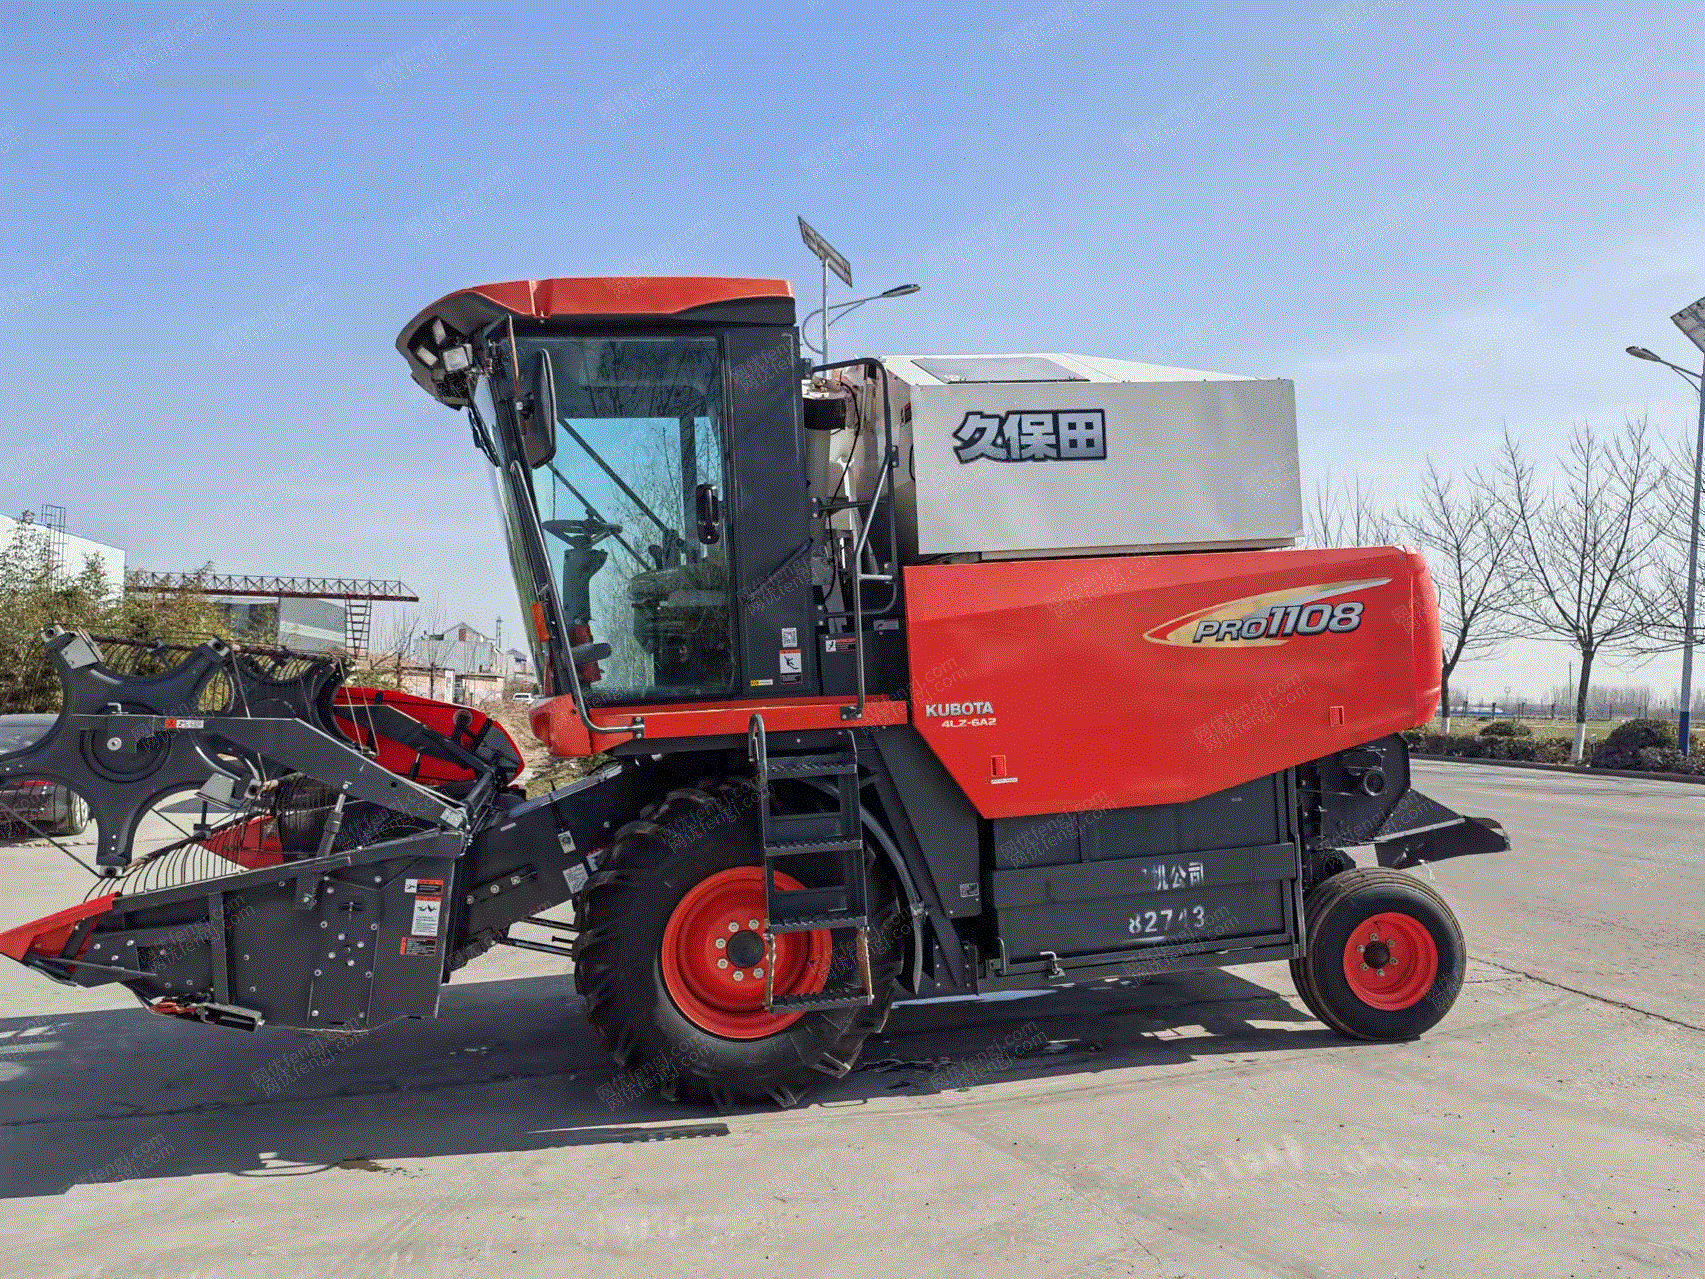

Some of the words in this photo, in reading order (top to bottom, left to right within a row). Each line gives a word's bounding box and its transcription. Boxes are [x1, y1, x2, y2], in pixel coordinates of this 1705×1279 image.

[952, 409, 1107, 464] 久保田
[1192, 601, 1365, 643] PRO1108
[925, 702, 994, 717] KUBOTA
[941, 717, 997, 728] 4LZ-6A2
